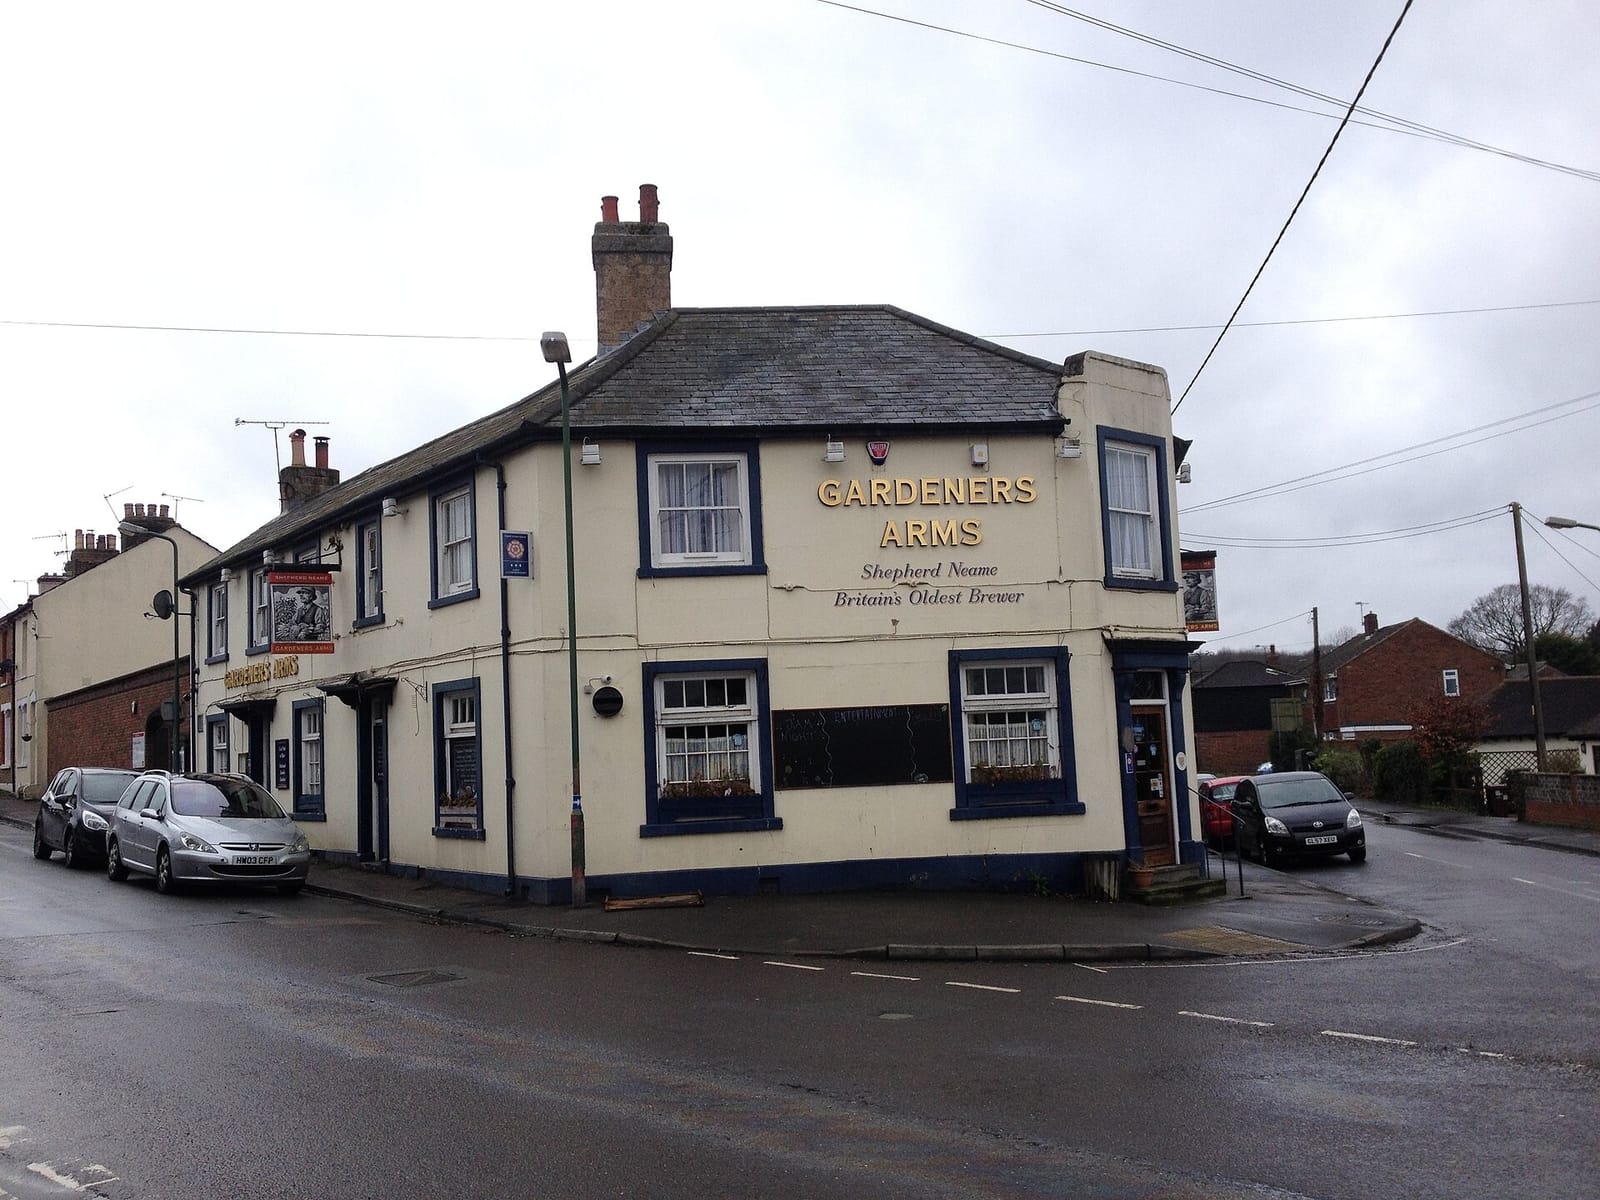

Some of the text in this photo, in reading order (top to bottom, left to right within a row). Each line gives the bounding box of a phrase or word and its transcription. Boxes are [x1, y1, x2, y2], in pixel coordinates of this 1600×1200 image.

[818, 476, 1038, 507] GARDENERS
[880, 519, 983, 547] ARMS
[861, 561, 998, 583] Shepherd Neame
[834, 588, 1025, 608] Britain's Oldest Brewer
[258, 856, 274, 864] CFP
